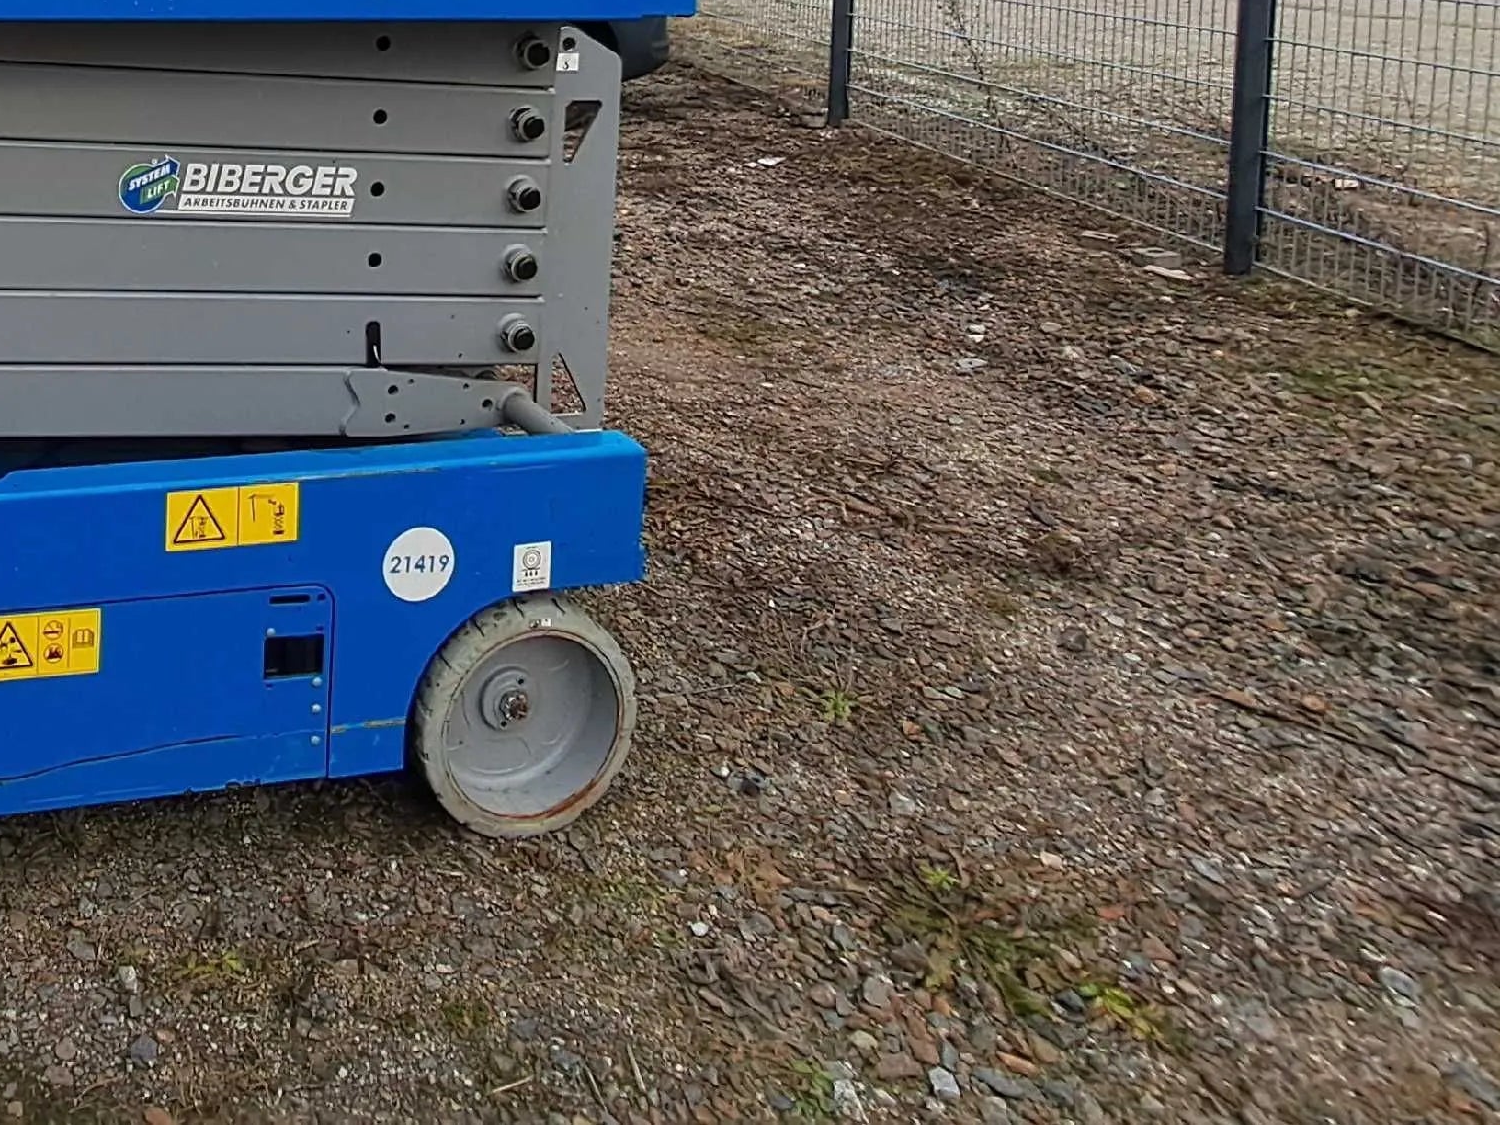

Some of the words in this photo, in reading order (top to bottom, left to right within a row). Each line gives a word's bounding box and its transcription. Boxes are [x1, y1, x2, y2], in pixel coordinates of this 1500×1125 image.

[128, 163, 171, 190] SYSTEM
[182, 163, 358, 196] BIBERGER
[147, 180, 171, 198] LIFT
[289, 200, 297, 210] &
[300, 200, 348, 212] STAPLER
[389, 554, 450, 574] 21419
